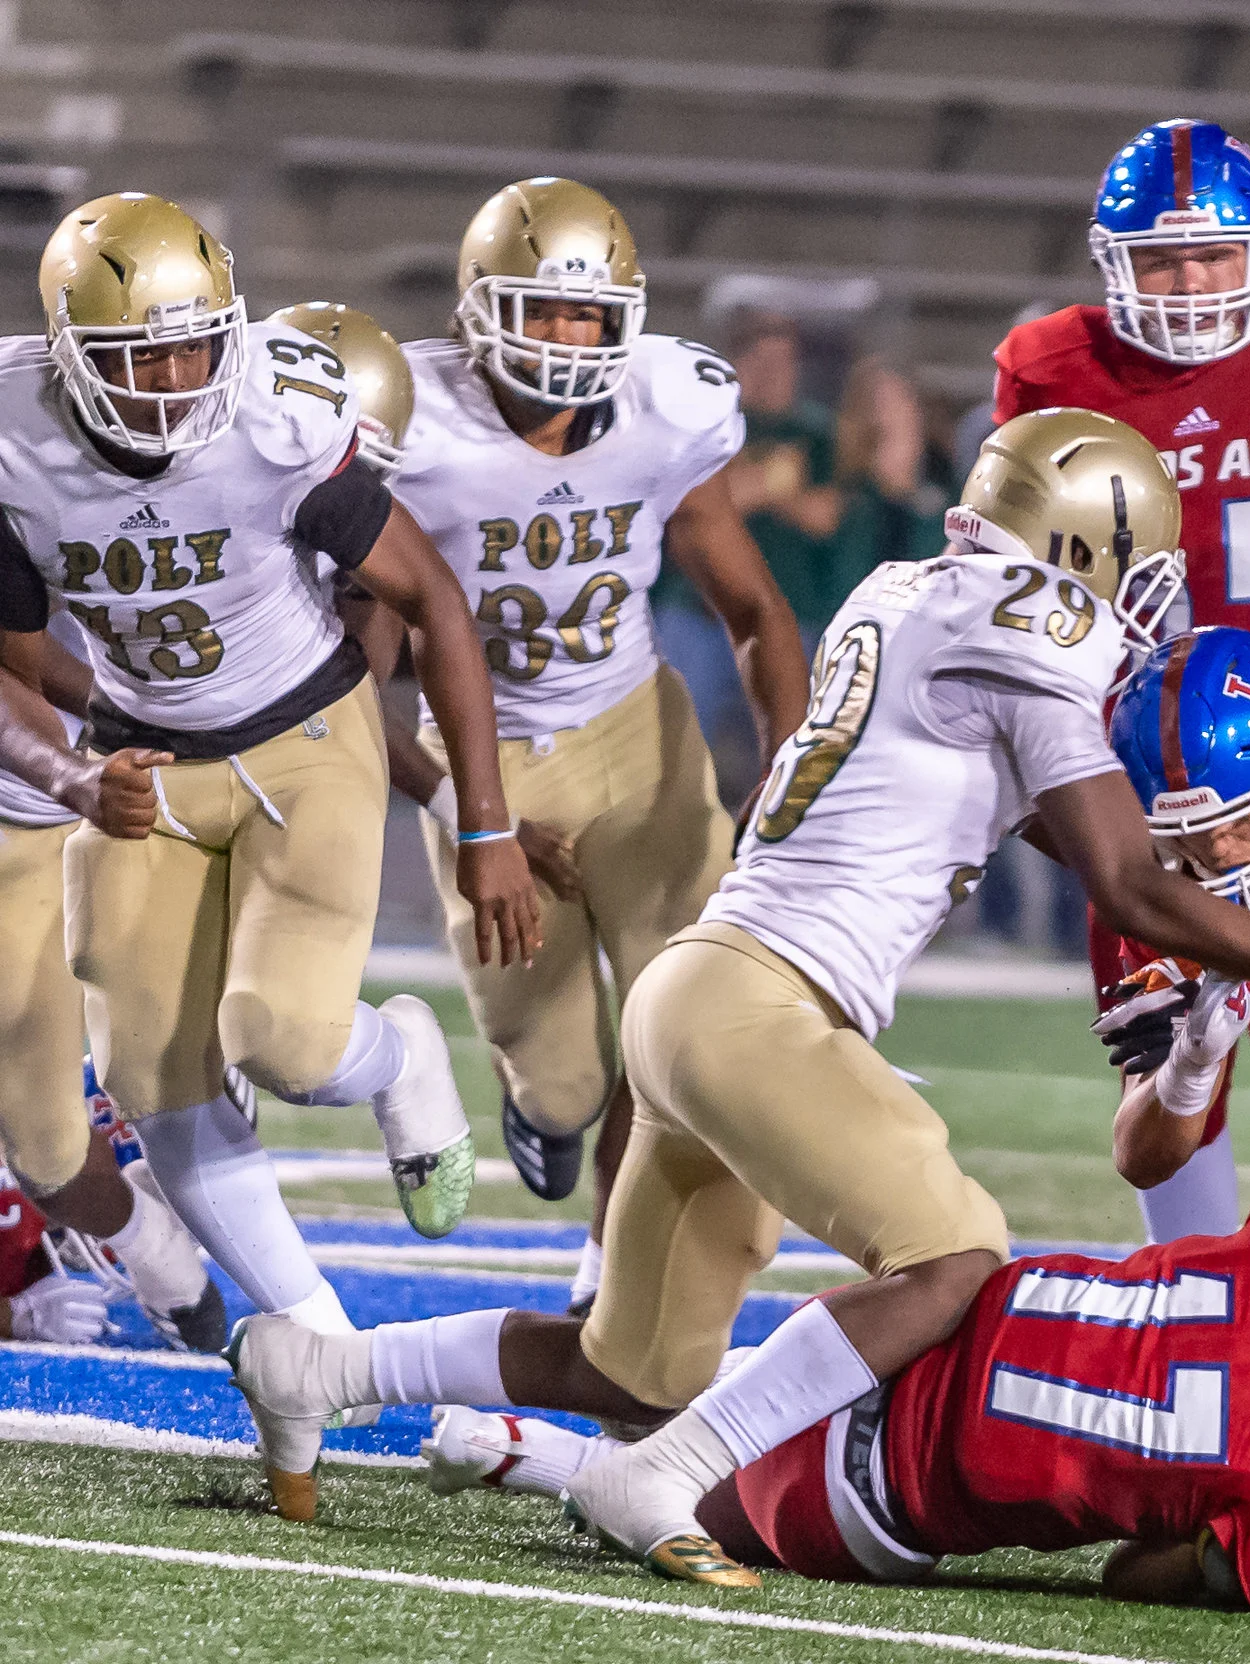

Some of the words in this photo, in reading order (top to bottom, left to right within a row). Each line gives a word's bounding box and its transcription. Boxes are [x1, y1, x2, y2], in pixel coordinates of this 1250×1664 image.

[266, 338, 348, 419] 13
[58, 528, 231, 595] POLY
[119, 519, 170, 529] adidas
[477, 499, 644, 571] POLY
[67, 599, 225, 672] 13
[475, 570, 632, 680] 30
[991, 565, 1096, 648] 29
[984, 1267, 1235, 1465] 17
